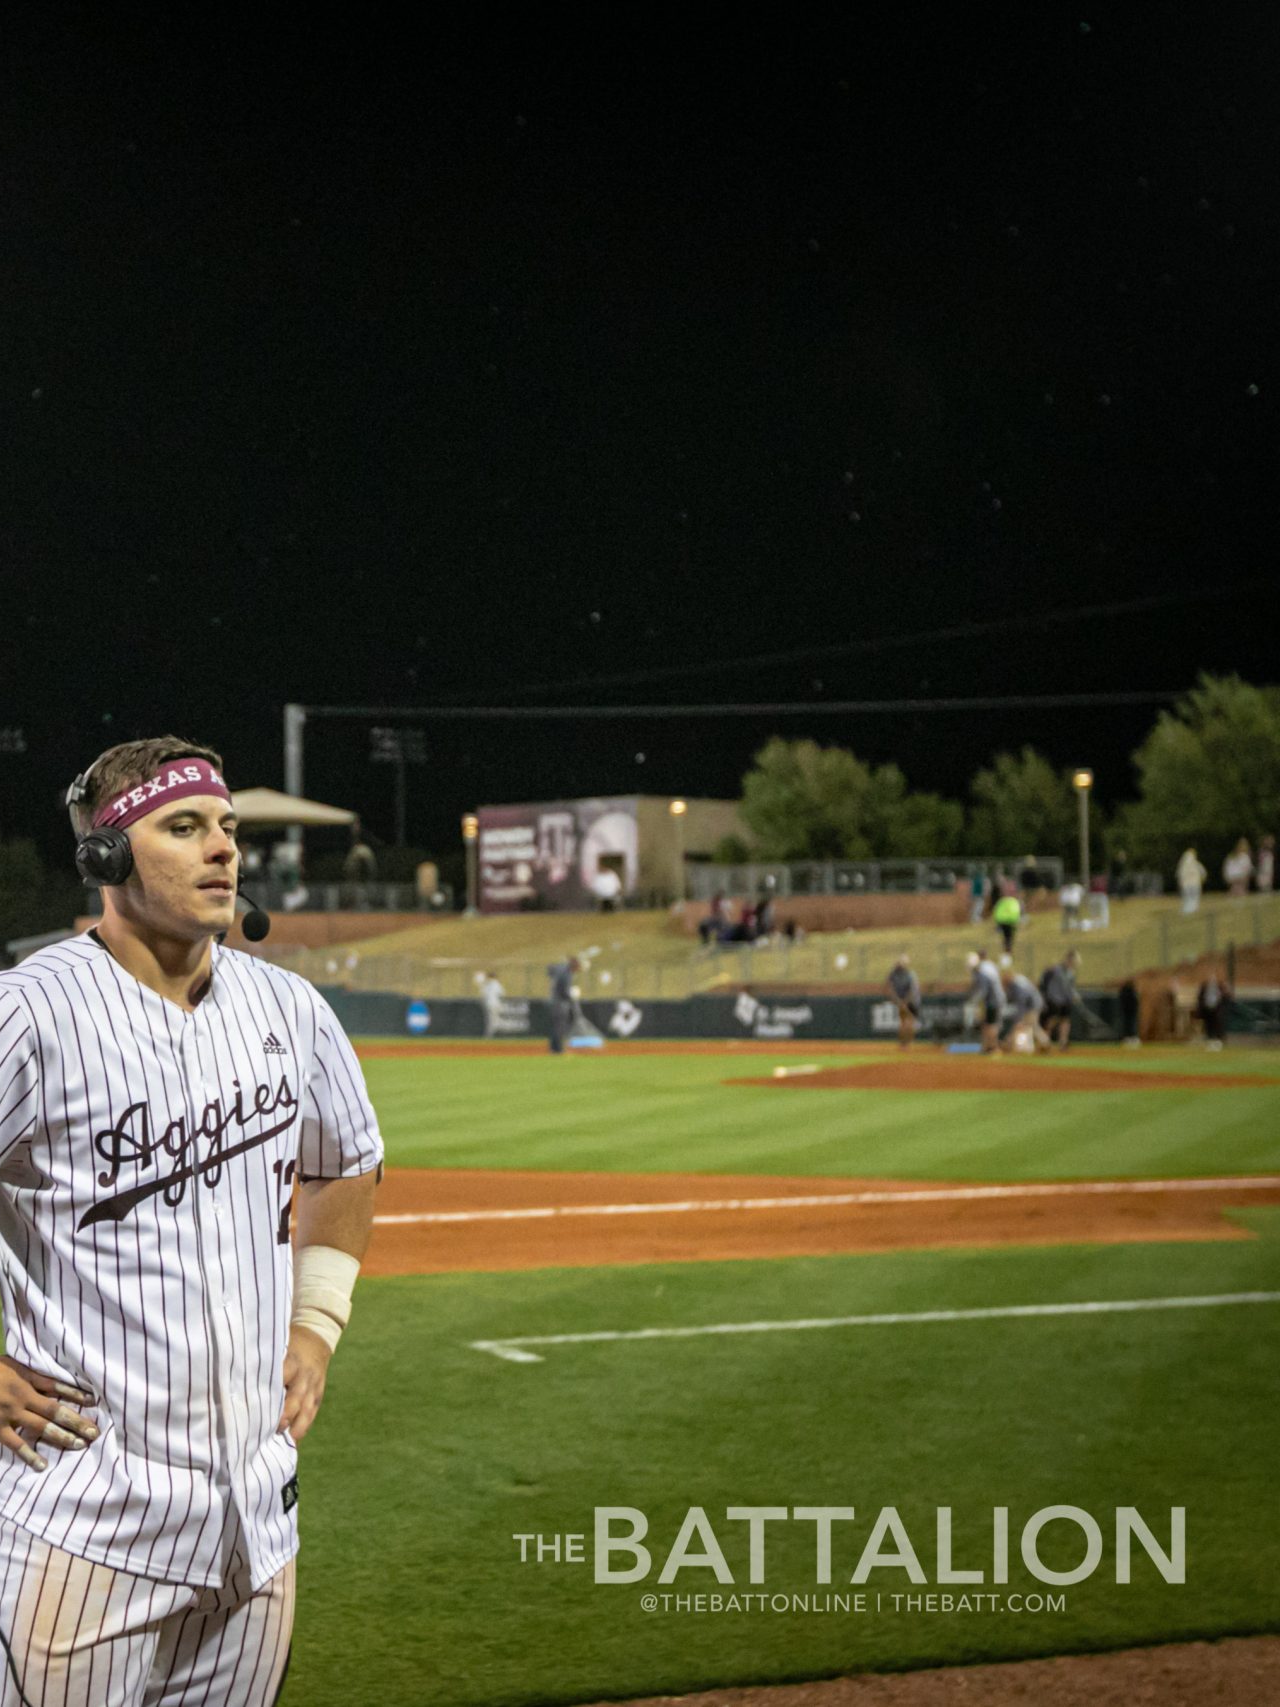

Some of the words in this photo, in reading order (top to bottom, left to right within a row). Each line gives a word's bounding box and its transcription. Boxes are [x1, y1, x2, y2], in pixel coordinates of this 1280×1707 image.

[113, 766, 201, 816] TEXAS
[263, 1046, 287, 1054] adidas
[95, 1074, 297, 1207] Aggies
